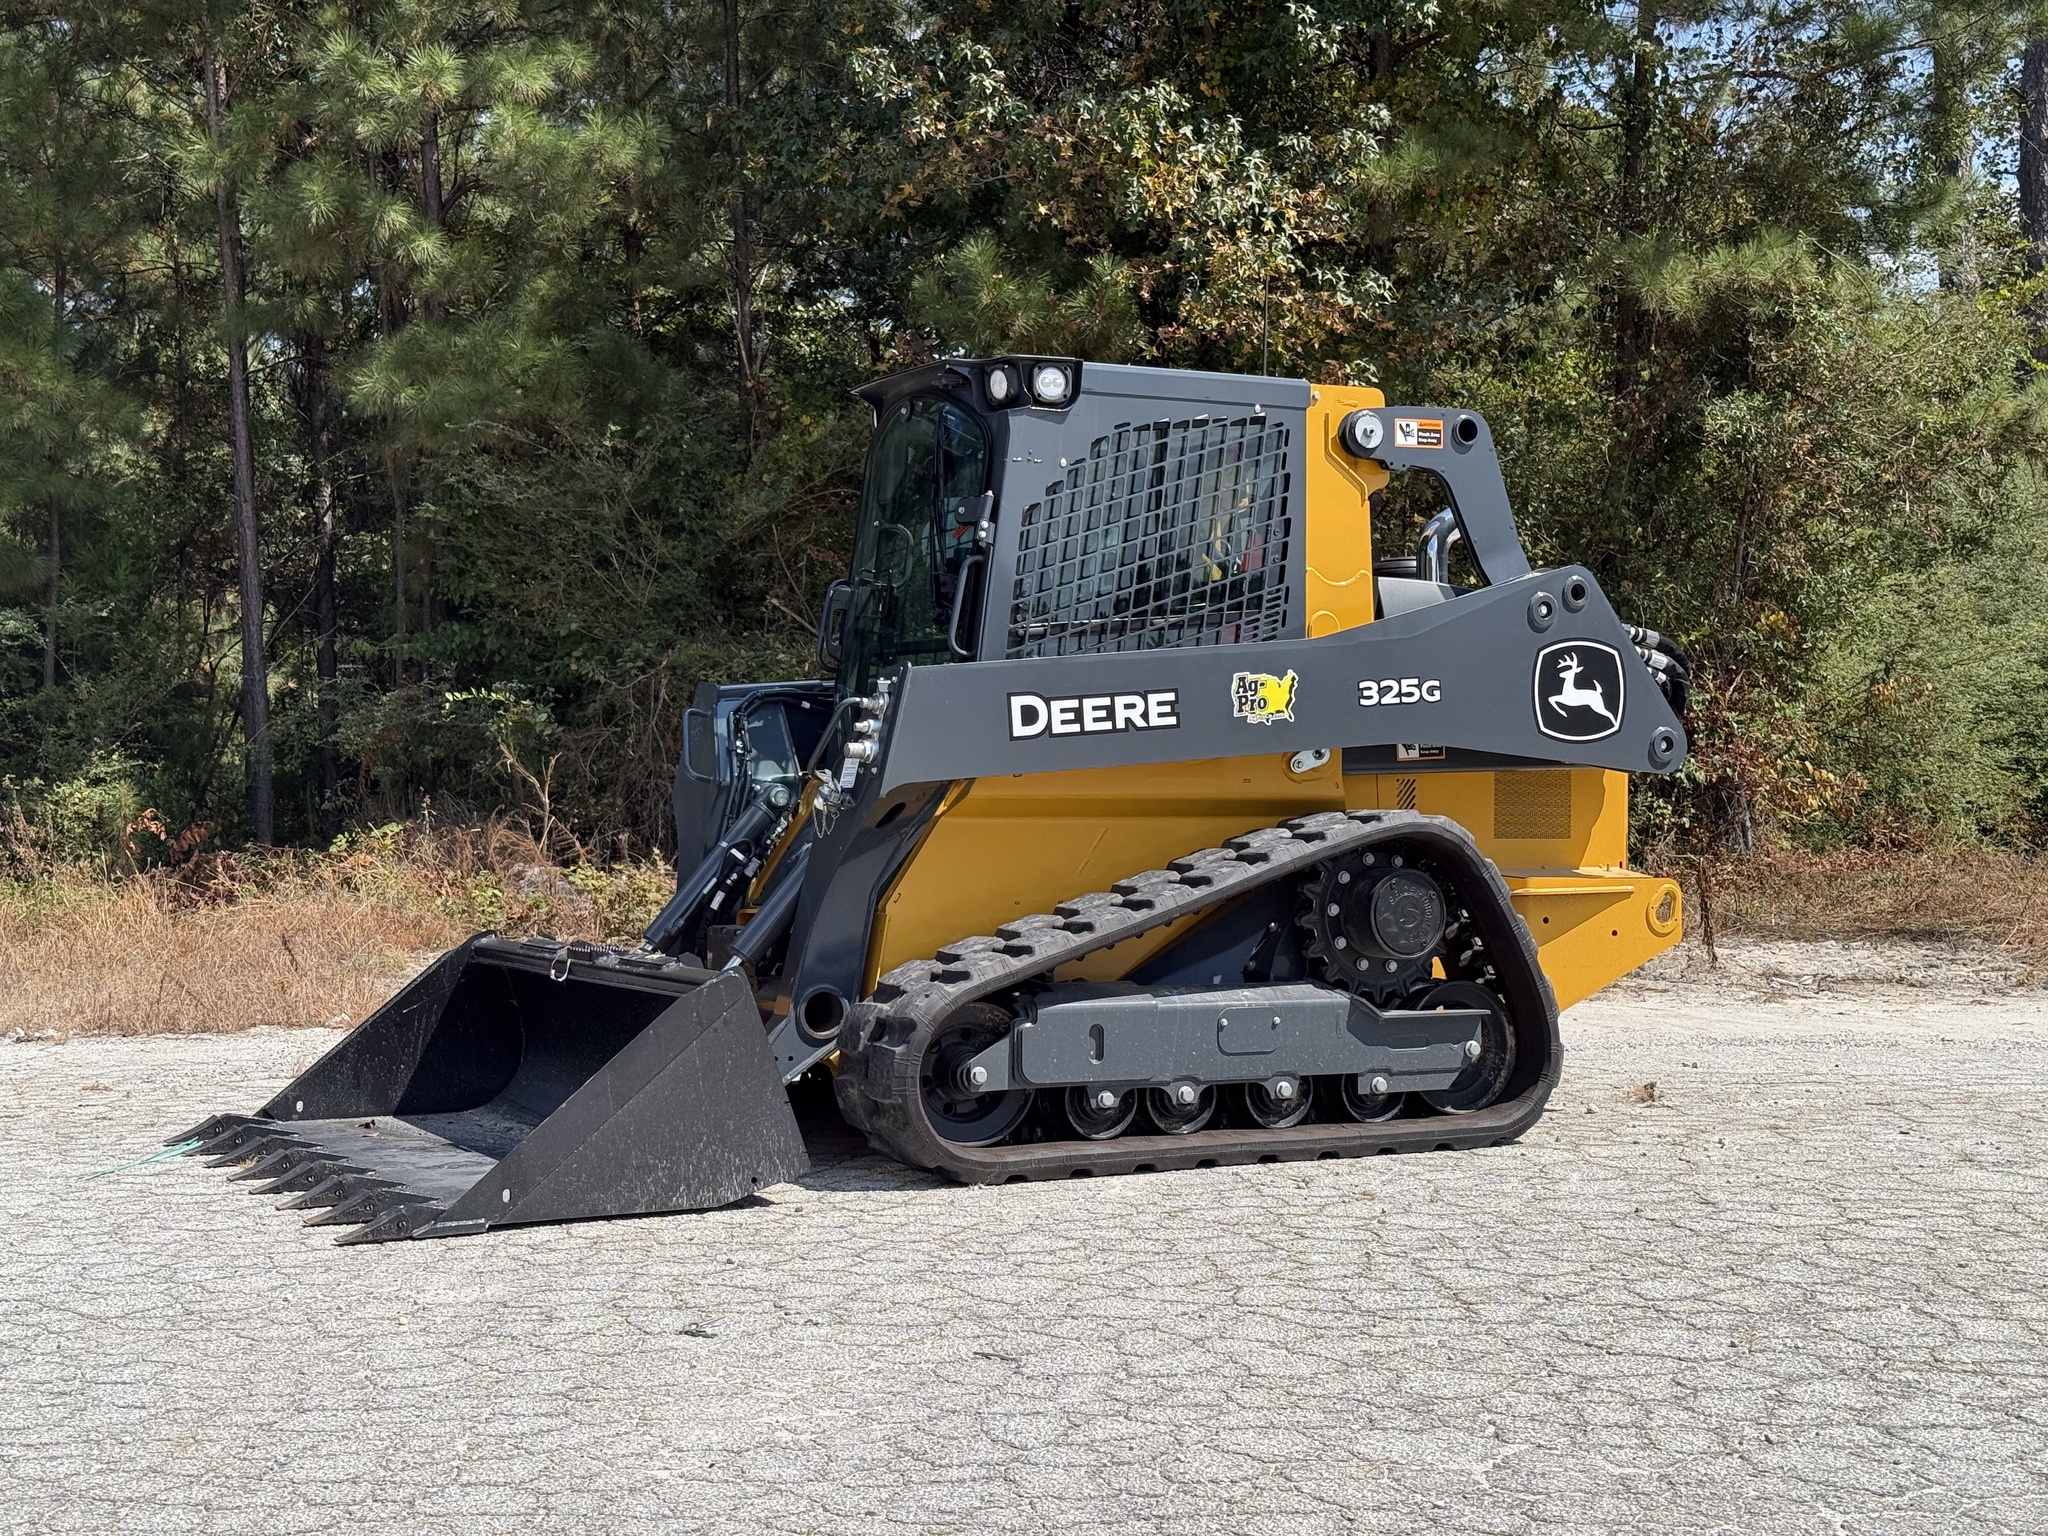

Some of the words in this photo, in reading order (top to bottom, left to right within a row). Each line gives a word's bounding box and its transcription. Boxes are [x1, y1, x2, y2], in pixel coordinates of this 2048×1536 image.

[1236, 676, 1265, 697] Ag-
[1358, 677, 1441, 706] 325G
[1009, 690, 1178, 739] DEERE
[1237, 695, 1268, 713] Pro
